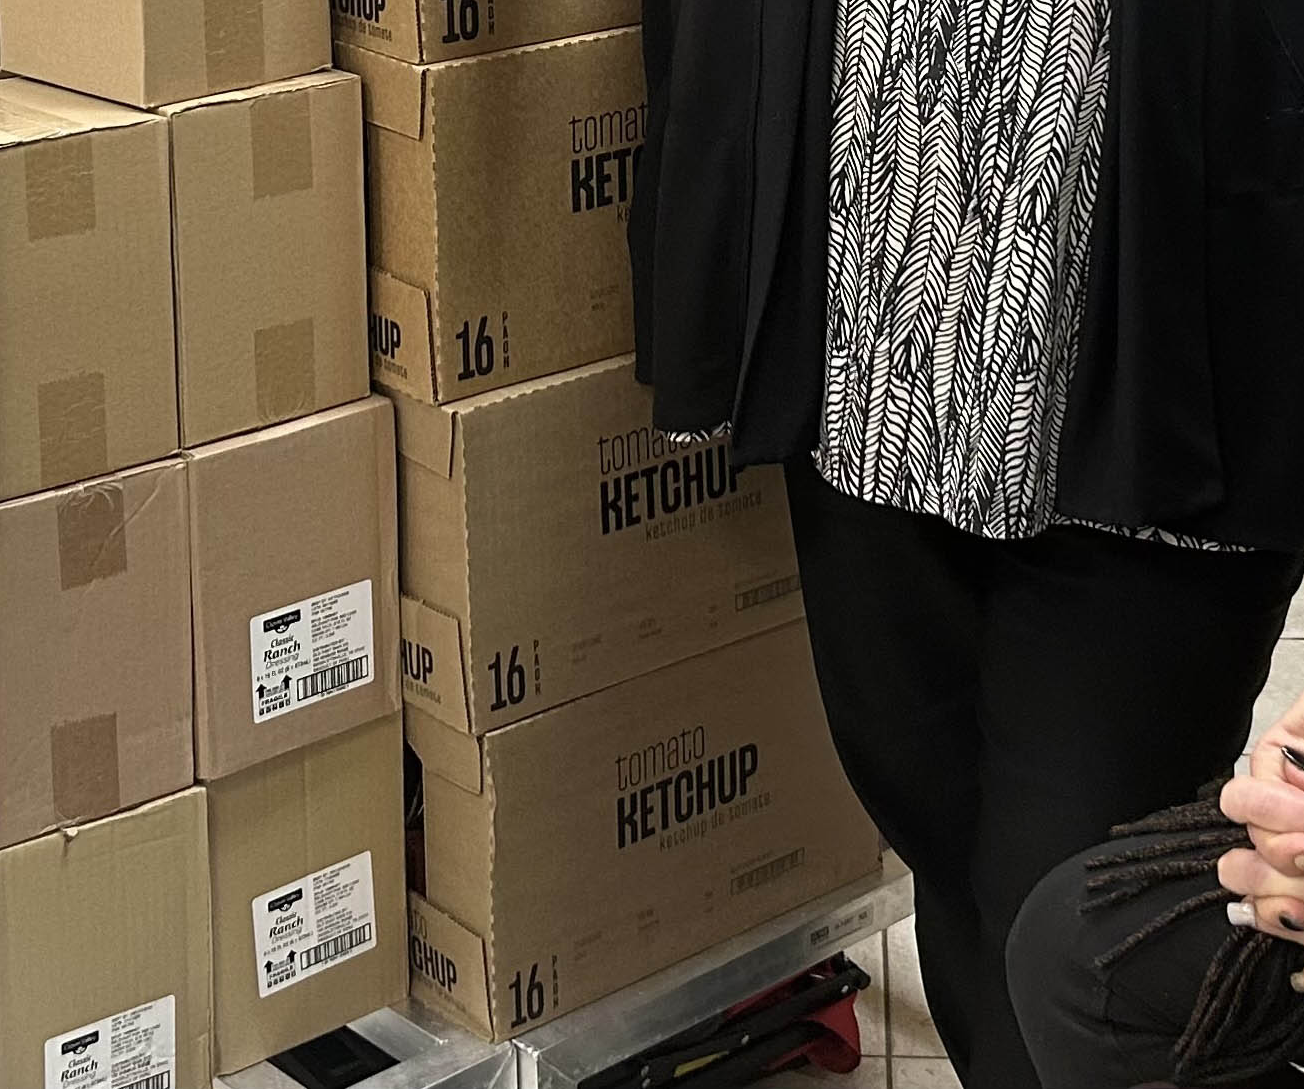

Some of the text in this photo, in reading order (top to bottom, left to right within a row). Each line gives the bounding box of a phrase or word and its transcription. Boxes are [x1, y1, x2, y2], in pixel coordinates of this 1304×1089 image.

[456, 316, 493, 381] 16
[264, 640, 300, 662] Ranch
[270, 634, 294, 648] Classic
[488, 646, 525, 711] 16
[615, 723, 706, 792] tomato
[616, 742, 759, 849] KETCHUP
[658, 814, 707, 852] ketchup
[269, 916, 303, 937] Ranch
[509, 964, 545, 1028] 16
[61, 1060, 98, 1082] Ranch
